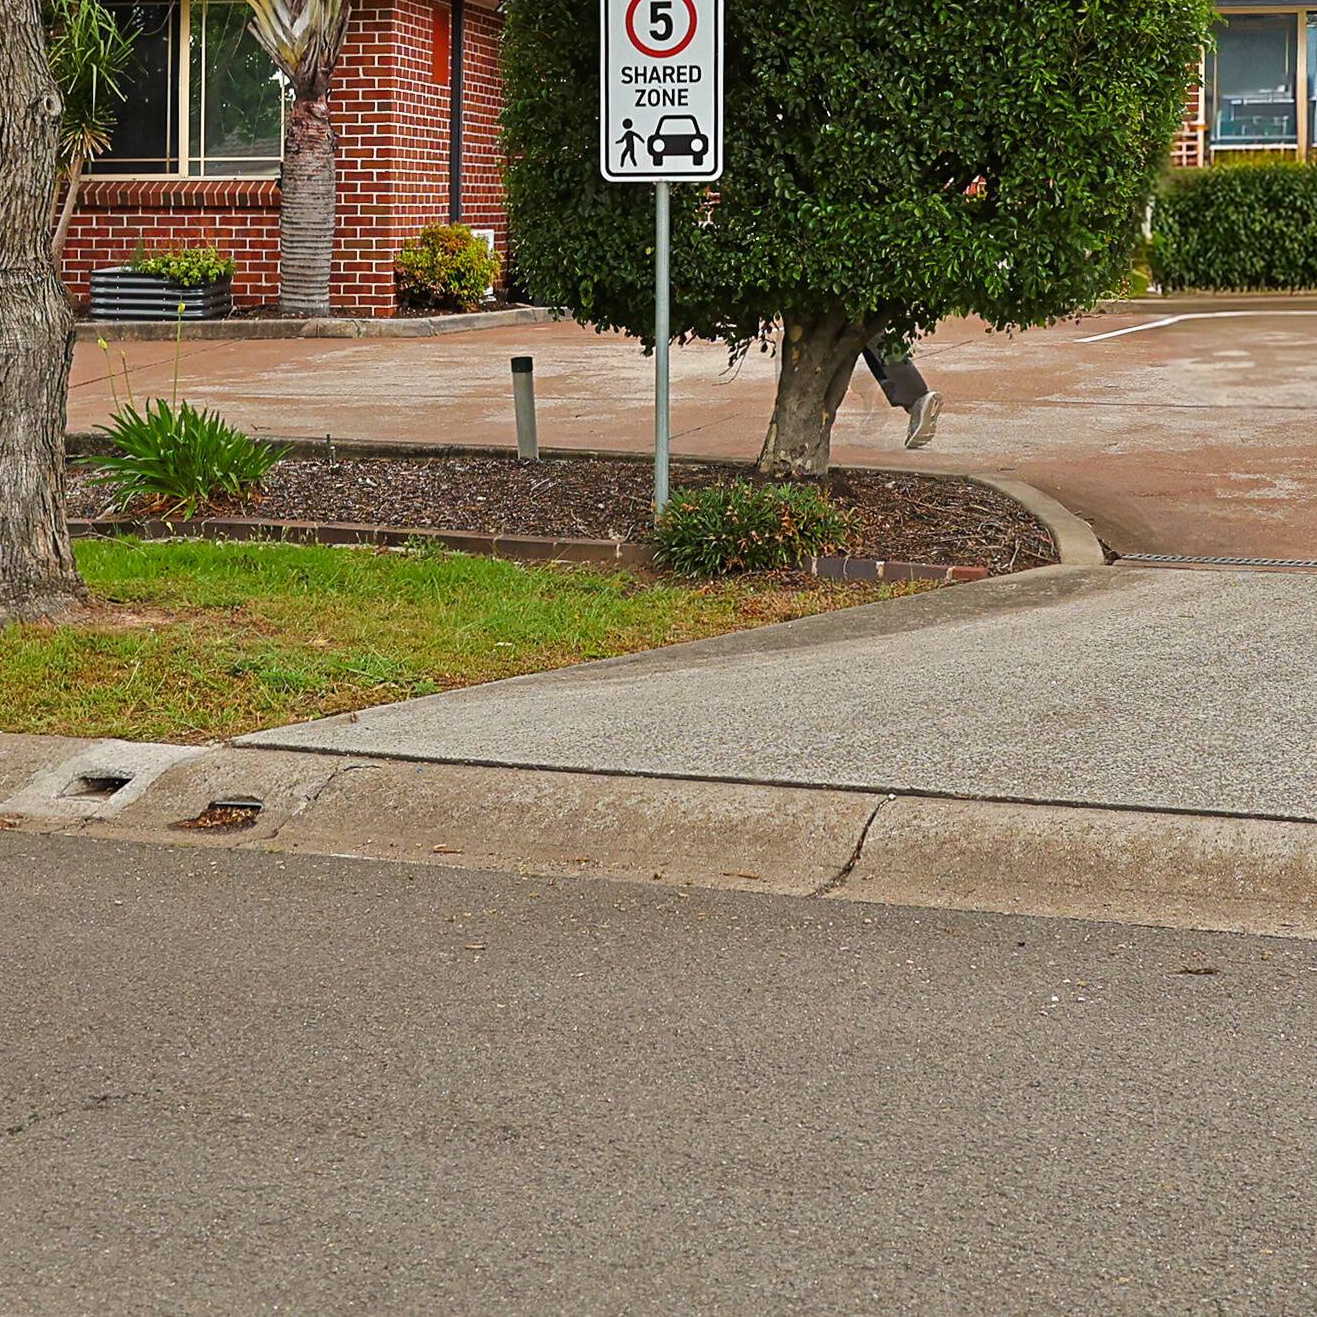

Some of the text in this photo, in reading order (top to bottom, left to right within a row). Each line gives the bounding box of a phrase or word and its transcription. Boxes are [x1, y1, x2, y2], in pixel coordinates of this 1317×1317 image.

[649, 1, 673, 41] 5
[621, 65, 702, 84] SHARED
[635, 89, 689, 107] ZONE
